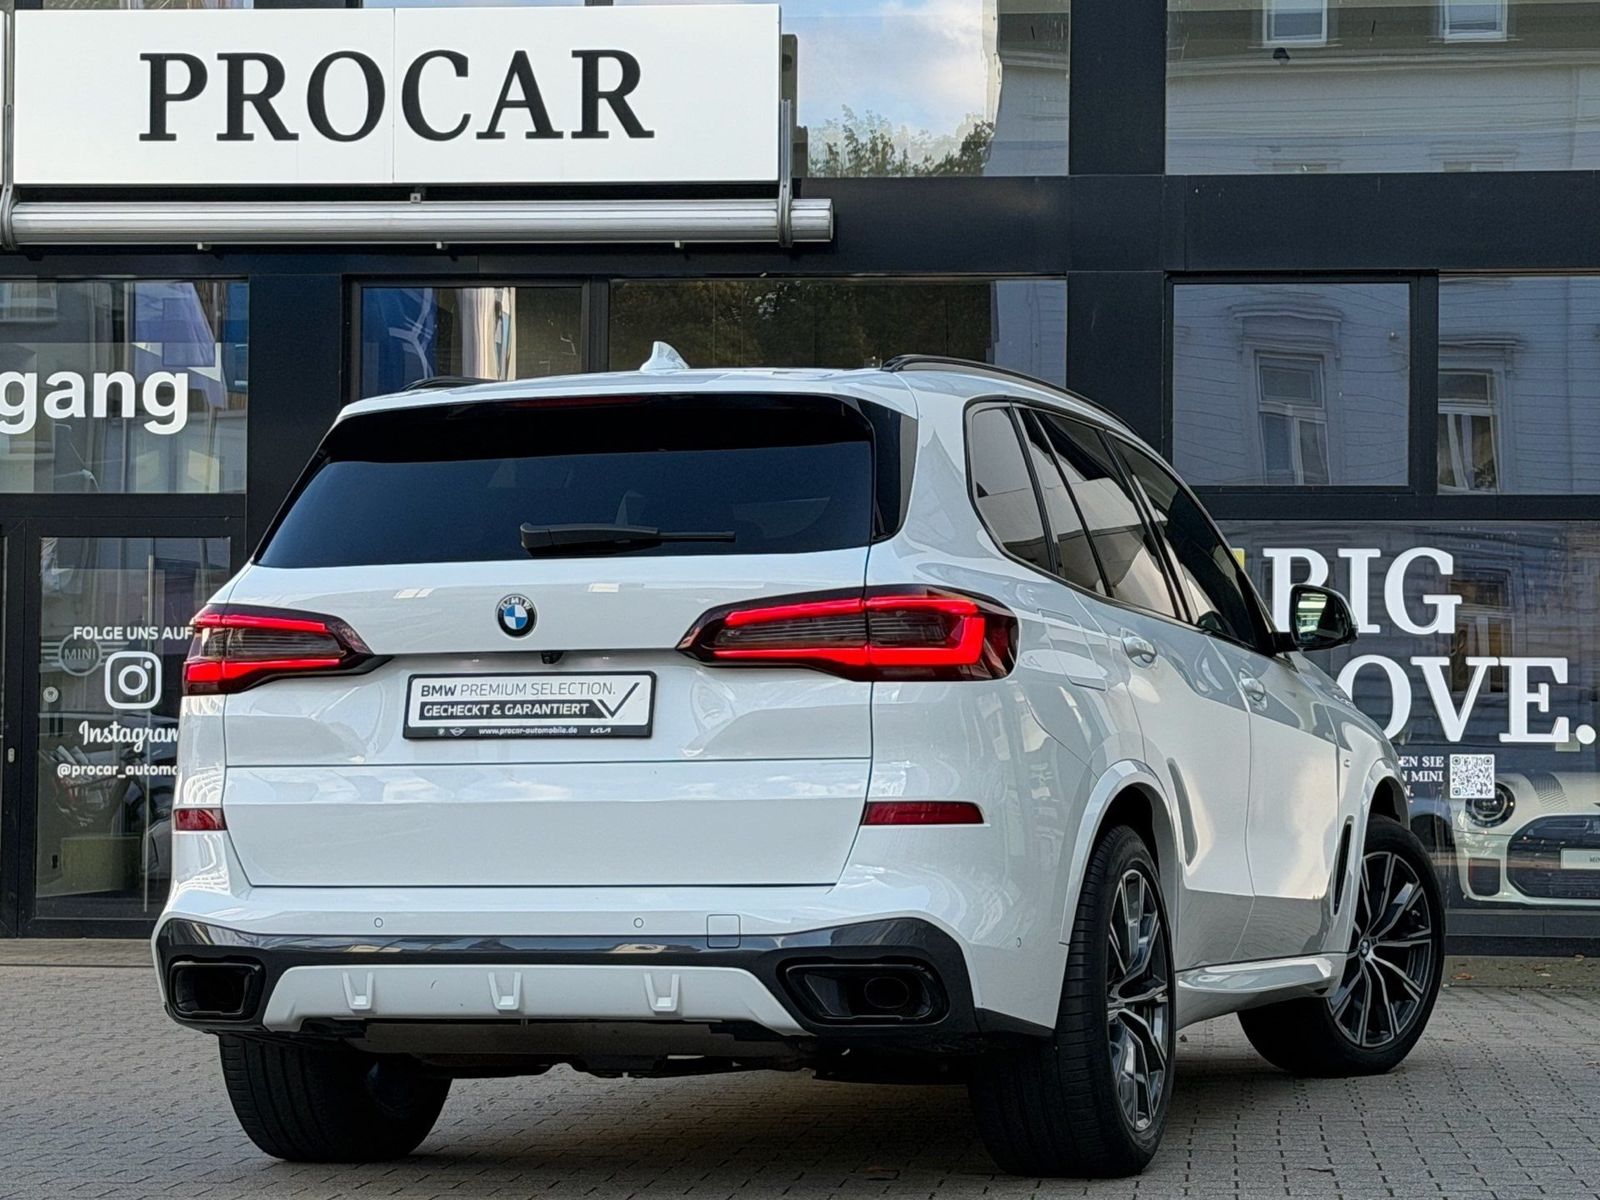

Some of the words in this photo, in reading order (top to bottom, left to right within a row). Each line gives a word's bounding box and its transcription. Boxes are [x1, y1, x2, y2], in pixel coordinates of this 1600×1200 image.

[139, 49, 655, 142] PROCAR
[0, 371, 189, 435] gang
[1262, 547, 1462, 635] BIG
[73, 626, 123, 640] FOLGE
[127, 626, 158, 640] UNS
[162, 626, 194, 640] AUF
[64, 649, 96, 660] MINI
[421, 685, 456, 697] BMW
[460, 683, 527, 697] PREMIUM
[530, 682, 616, 696] SELECTION.
[424, 705, 490, 717] GECHECKT
[491, 704, 501, 715] &
[504, 703, 589, 716] GARANTIERT
[478, 727, 578, 736] www.procar-automobile.de
[1422, 756, 1444, 767] SIE
[1411, 771, 1443, 781] MINI
